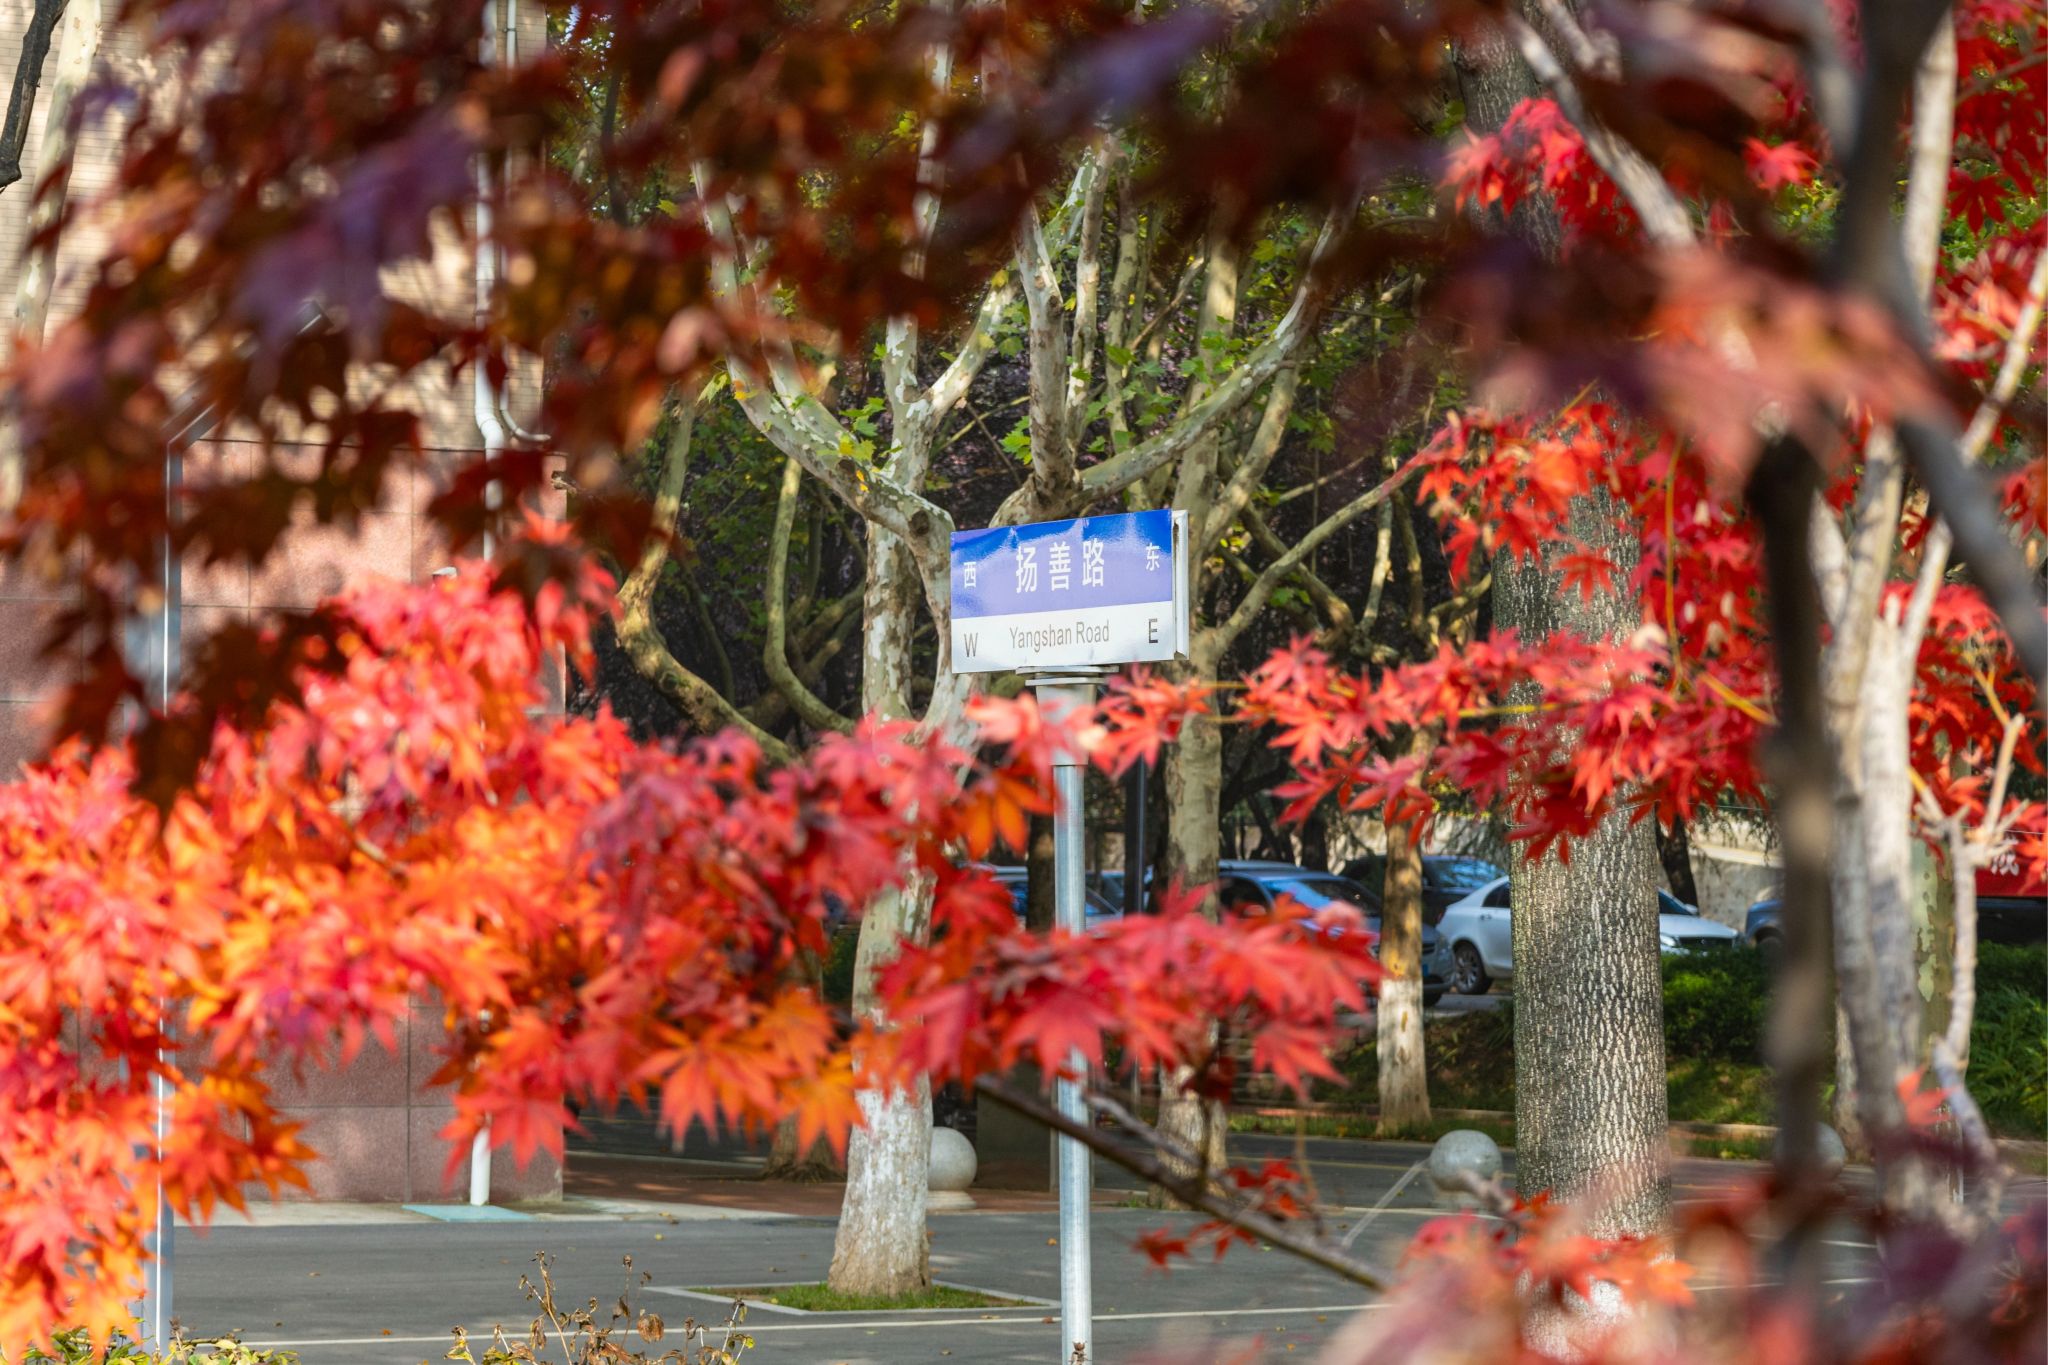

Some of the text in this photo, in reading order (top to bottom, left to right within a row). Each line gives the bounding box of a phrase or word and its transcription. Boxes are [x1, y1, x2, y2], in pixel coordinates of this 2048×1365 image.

[963, 538, 1160, 593] 西 扬善路 东
[964, 618, 1159, 657] W Yangshan Road E
